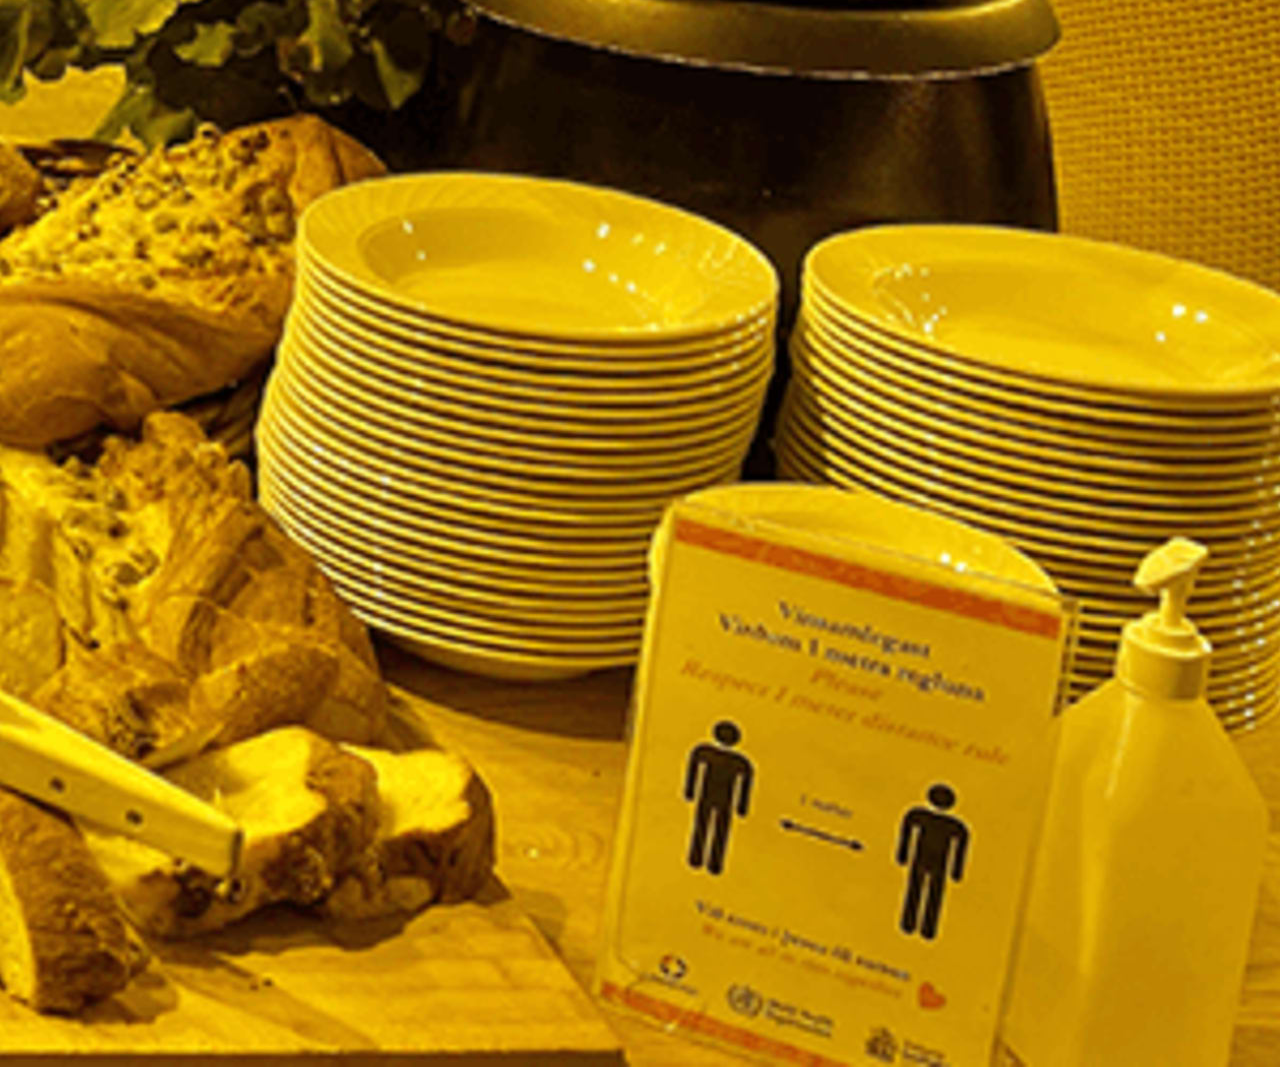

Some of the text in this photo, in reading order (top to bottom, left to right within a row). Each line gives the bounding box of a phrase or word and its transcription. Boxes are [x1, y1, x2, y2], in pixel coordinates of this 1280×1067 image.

[681, 656, 769, 697] Respect
[860, 710, 959, 753] distance
[962, 743, 1012, 767] rule
[808, 667, 884, 701] Please
